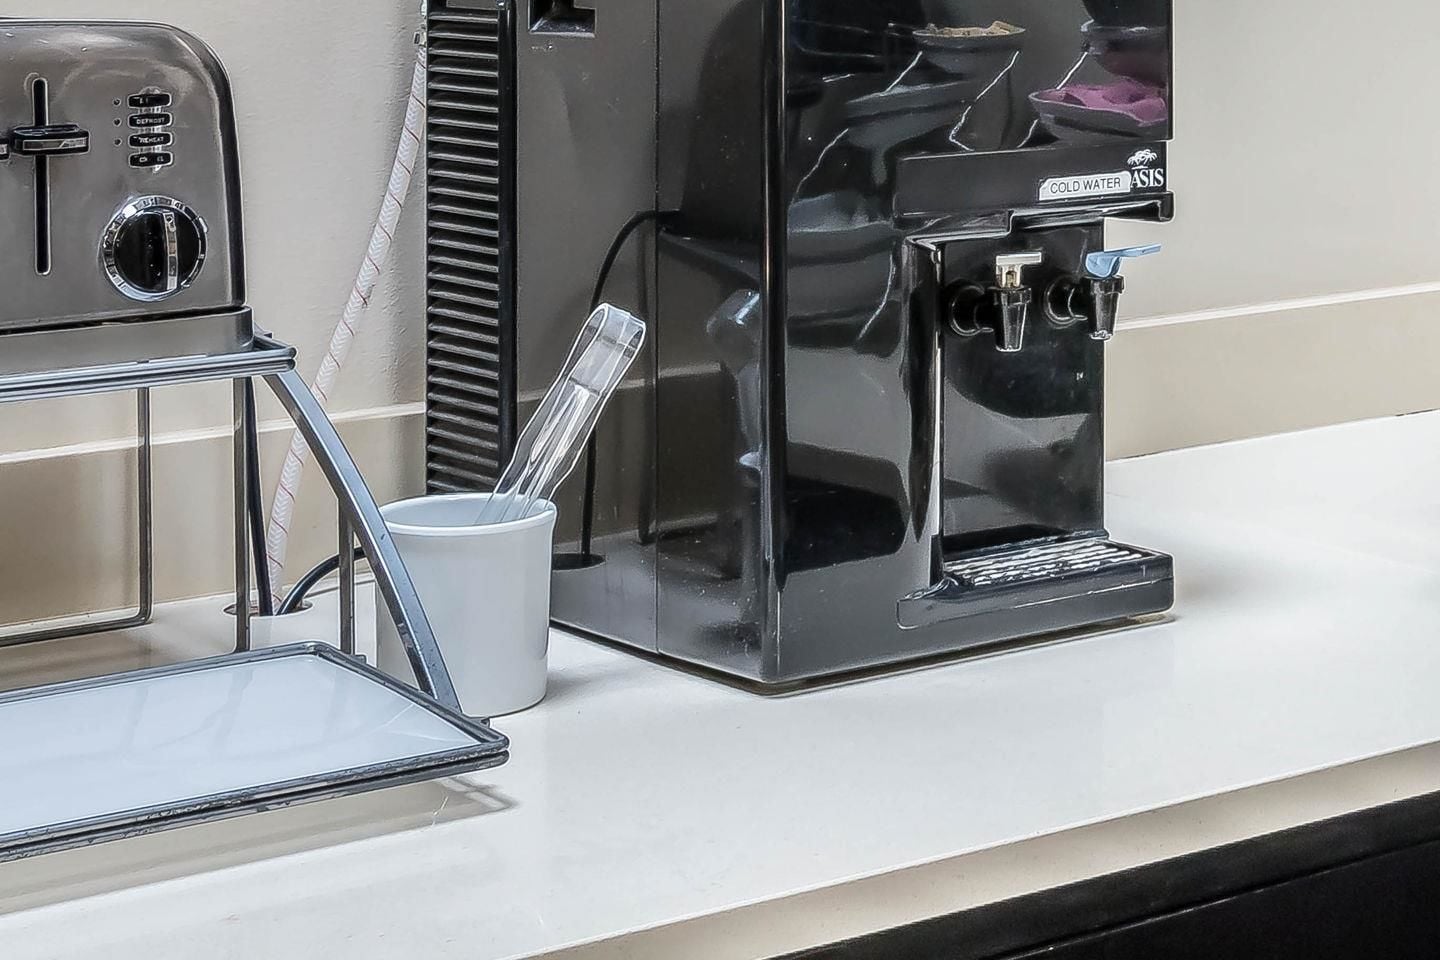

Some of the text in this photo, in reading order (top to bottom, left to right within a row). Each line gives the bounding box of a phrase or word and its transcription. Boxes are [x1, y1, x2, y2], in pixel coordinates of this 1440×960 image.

[1050, 177, 1121, 194] COLD WATER
[1130, 168, 1164, 188] ASIS
